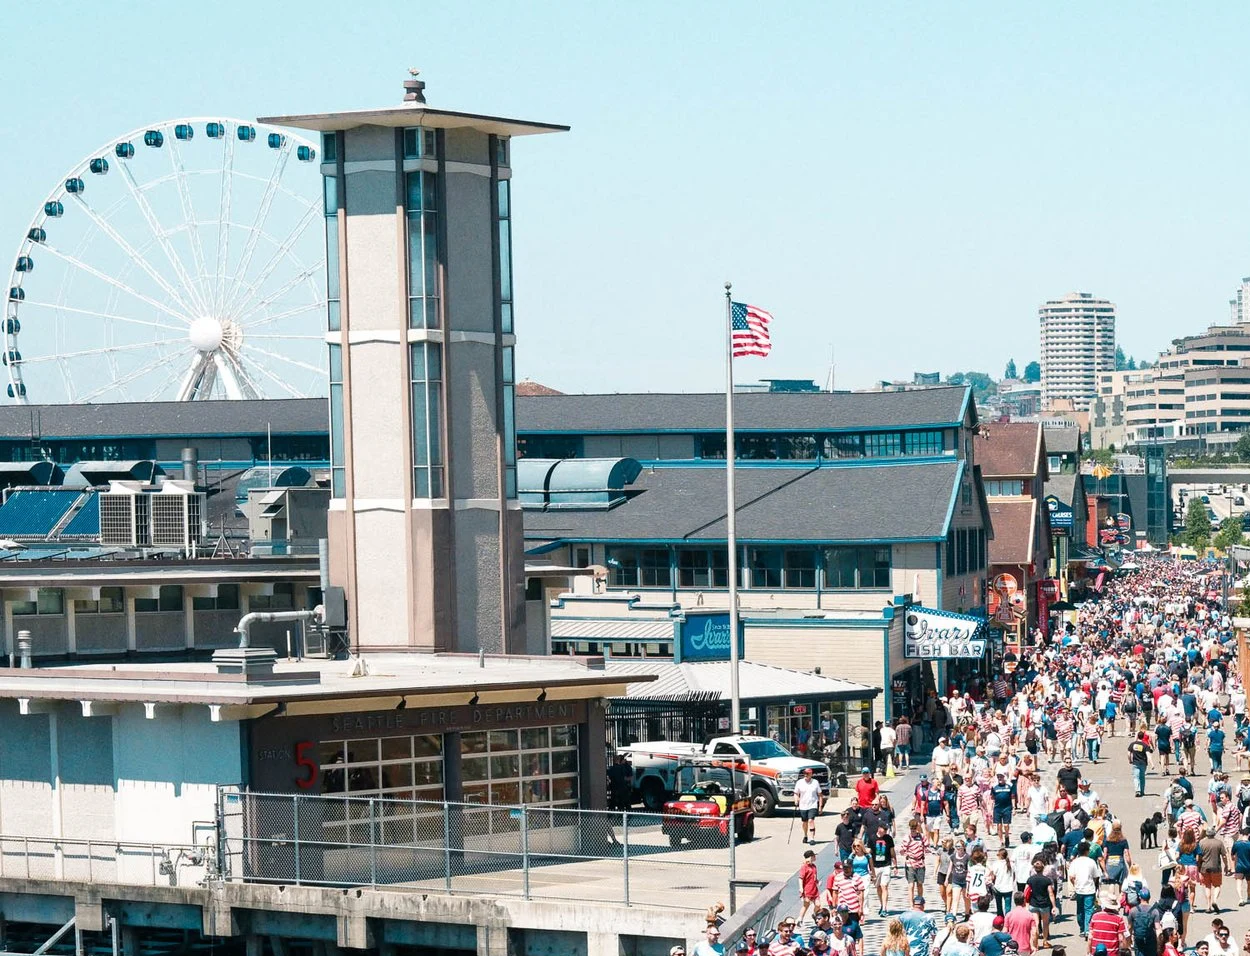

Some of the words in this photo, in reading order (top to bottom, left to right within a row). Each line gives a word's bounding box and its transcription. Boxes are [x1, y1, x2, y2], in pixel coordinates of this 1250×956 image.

[906, 619, 970, 640] Ivar's
[906, 644, 941, 656] FISH
[949, 644, 982, 656] BAR
[333, 713, 403, 732] SEATTLE
[420, 710, 457, 726] FIRE
[473, 703, 577, 724] DEPARTMENT
[257, 749, 292, 761] STATION
[294, 740, 319, 790] 5
[972, 872, 985, 888] 15
